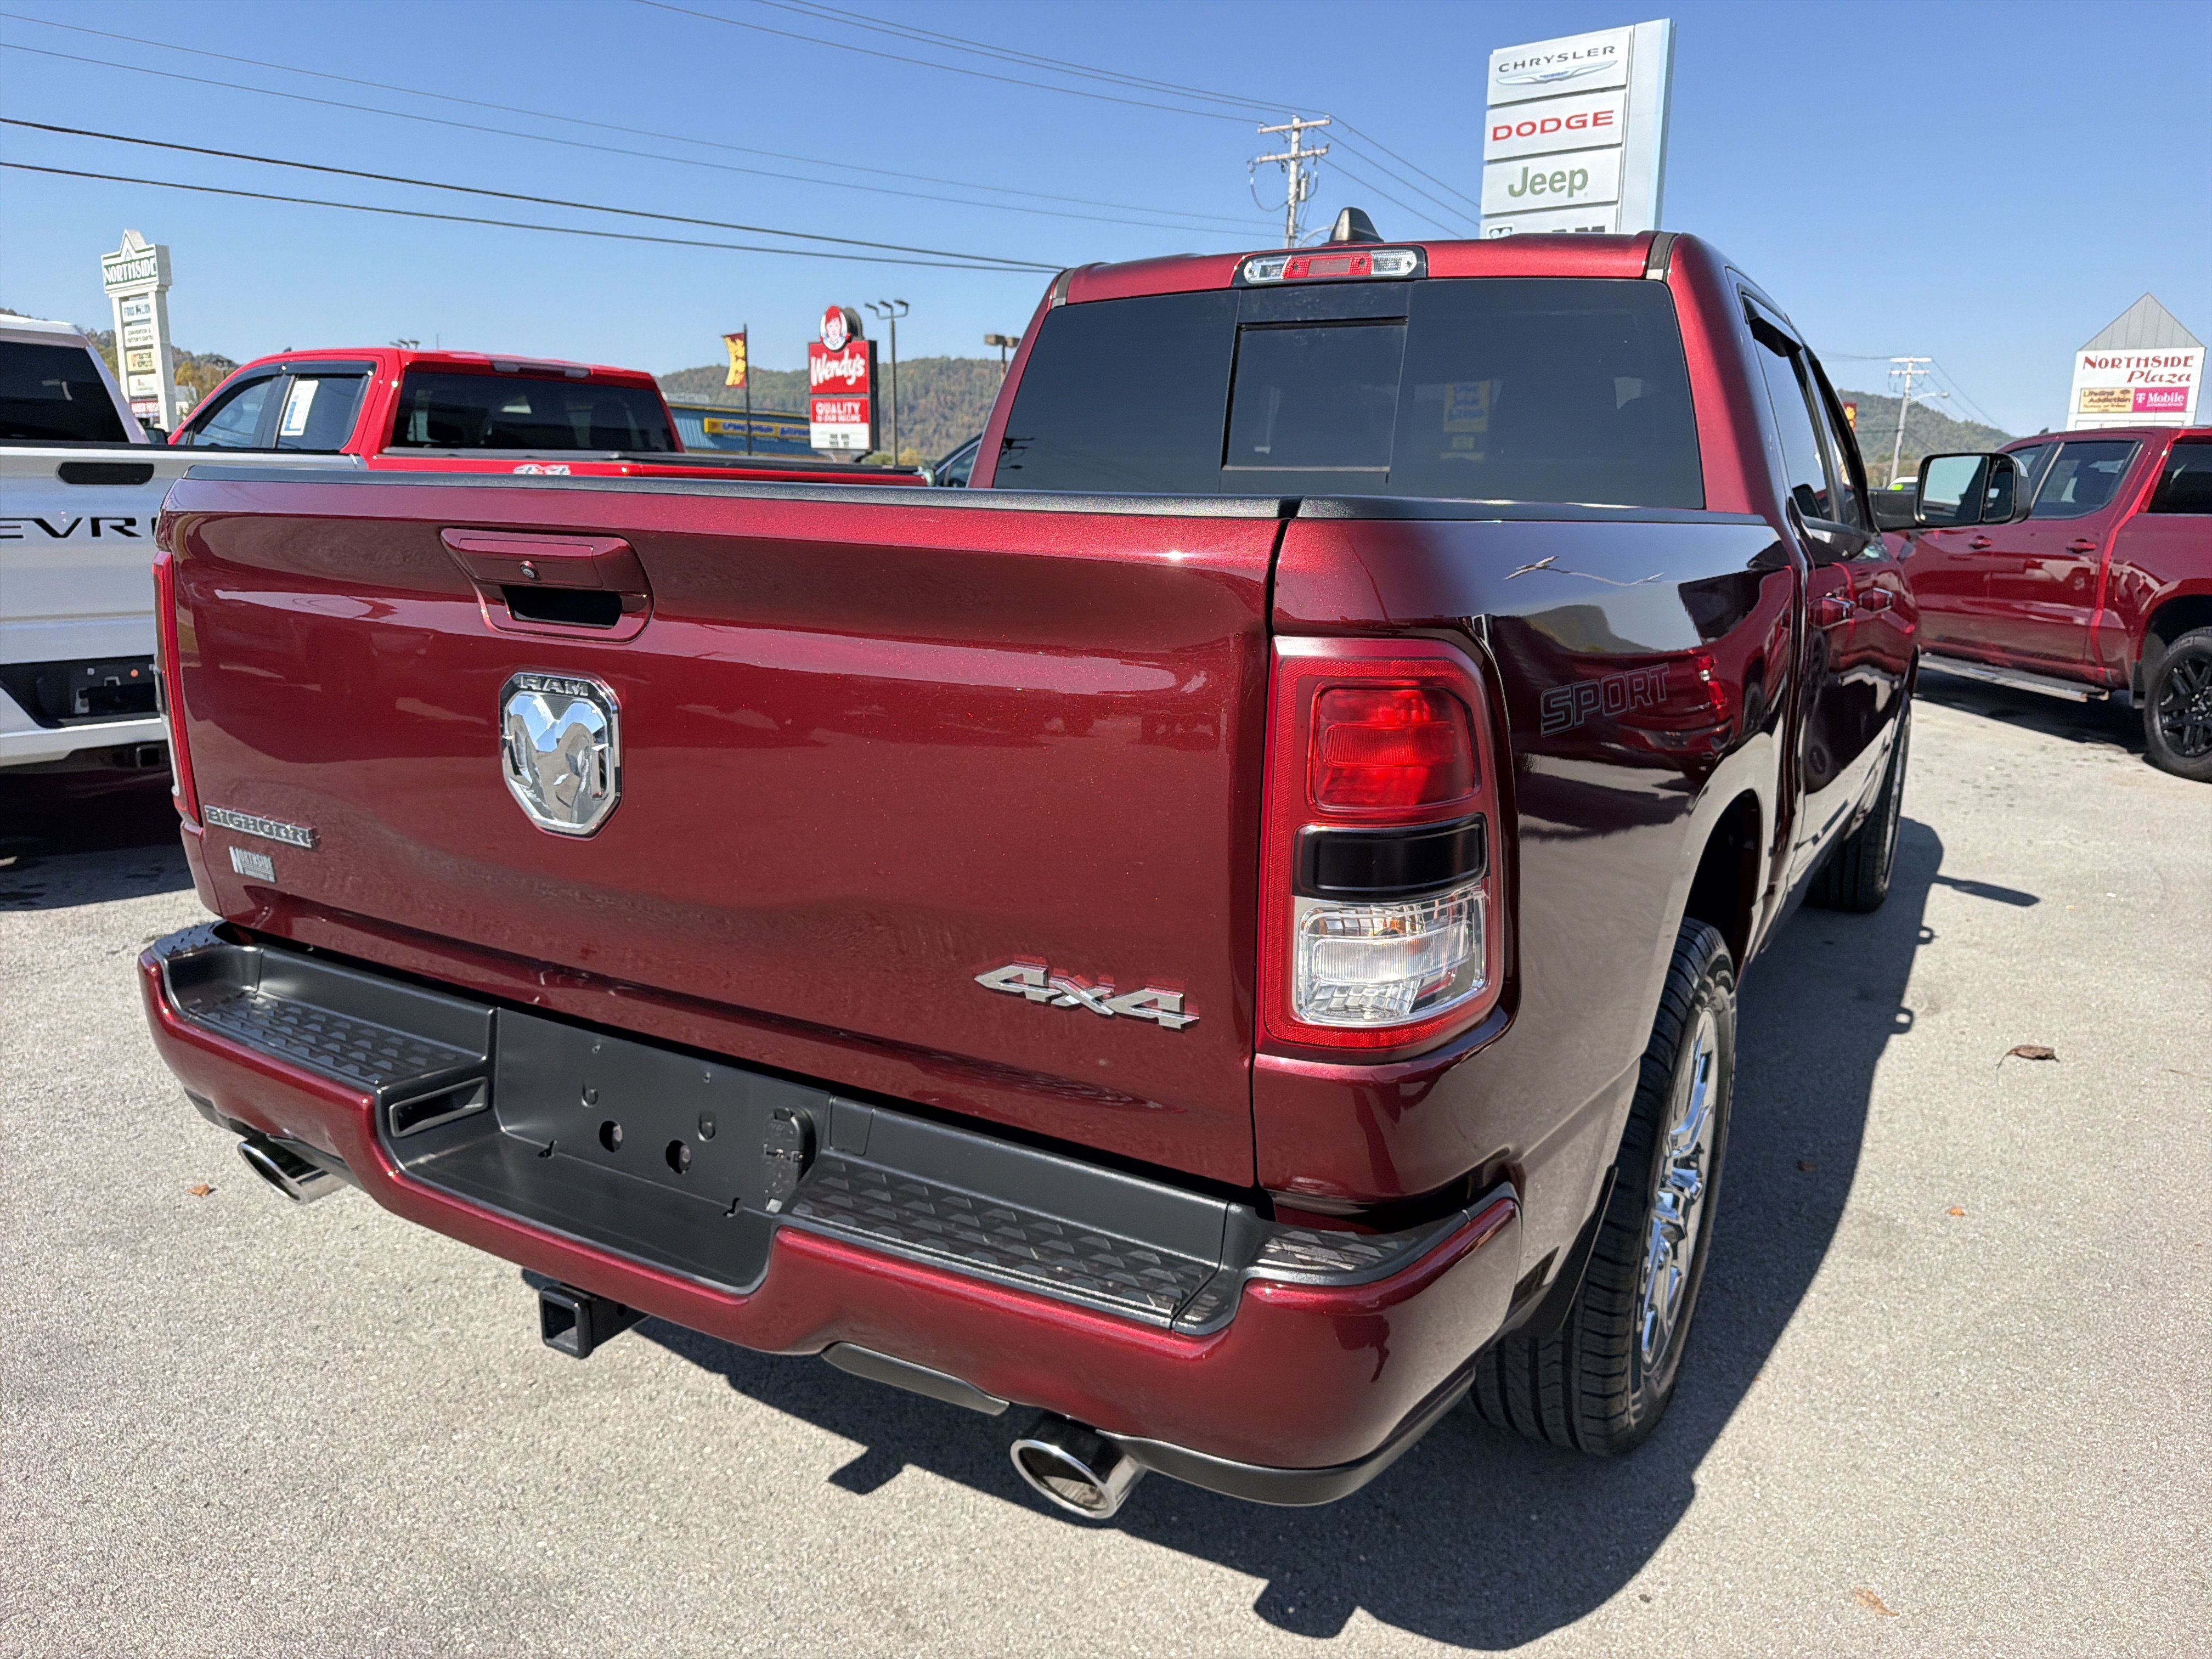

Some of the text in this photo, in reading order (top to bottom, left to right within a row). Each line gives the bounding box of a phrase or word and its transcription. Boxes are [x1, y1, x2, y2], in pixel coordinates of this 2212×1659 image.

[1498, 46, 1615, 72] CHRYSLER
[1492, 110, 1614, 141] DODGE
[1508, 166, 1588, 198] Jeep
[104, 257, 156, 284] NORTHSIDE
[810, 347, 865, 386] Wendy's
[2083, 356, 2194, 370] NORTHSIDE
[2127, 370, 2192, 383] Plaza
[816, 402, 861, 415] QUALITY
[2147, 392, 2185, 404] Mobile
[0, 517, 157, 538] EVR
[520, 675, 588, 696] RAM
[1541, 662, 1670, 738] SPORT
